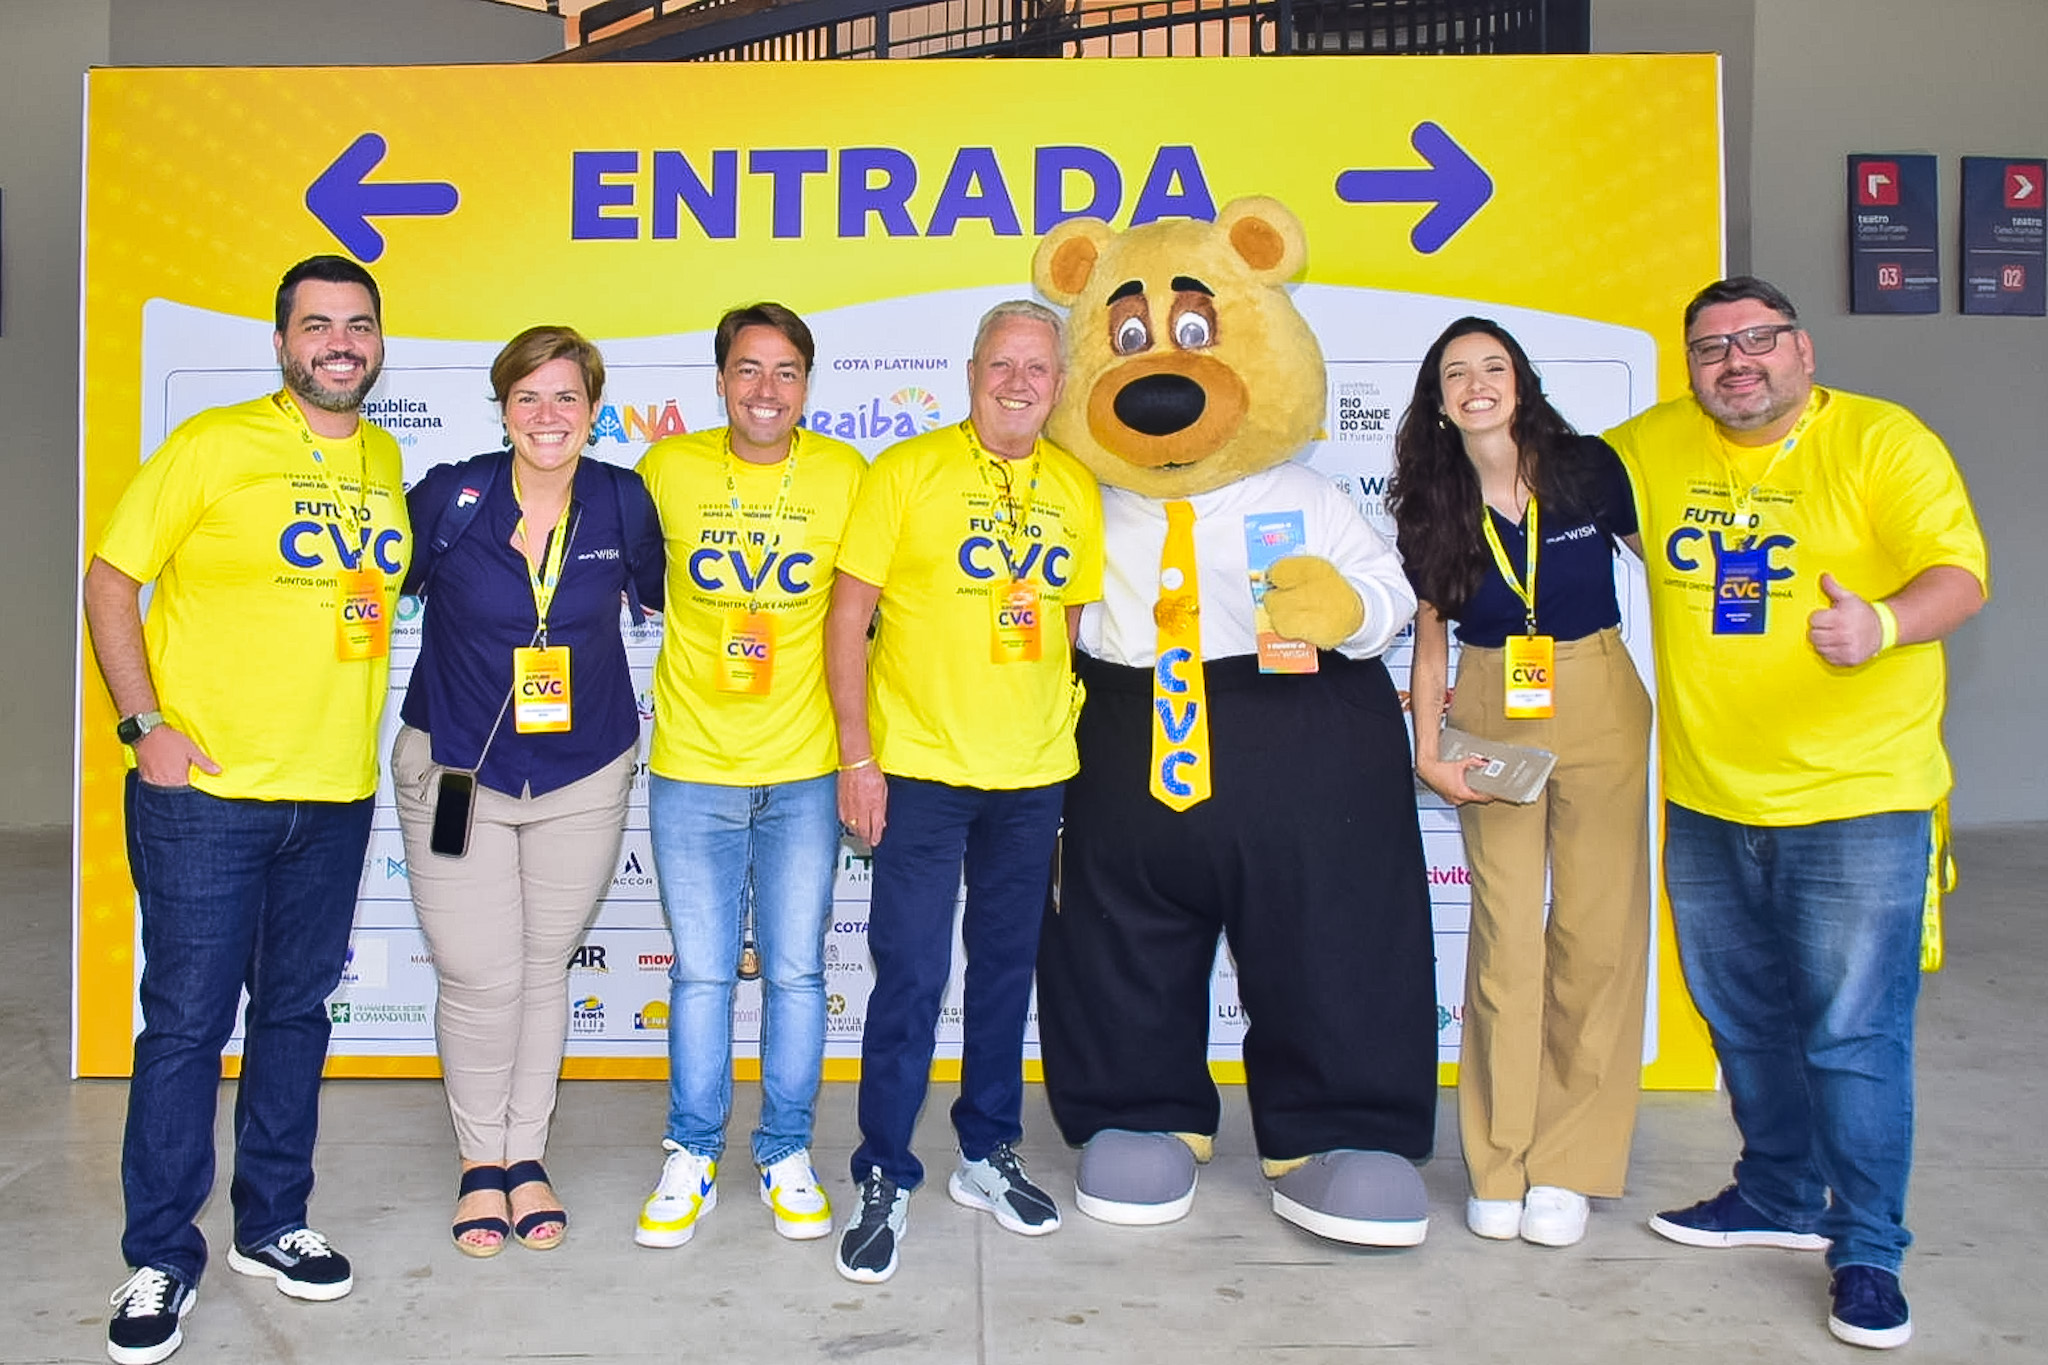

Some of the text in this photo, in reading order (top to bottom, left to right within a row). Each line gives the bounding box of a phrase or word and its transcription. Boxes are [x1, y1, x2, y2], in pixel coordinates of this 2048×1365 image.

[571, 145, 1216, 240] ENTRADA
[1879, 267, 1899, 286] 03
[2003, 269, 2022, 287] 02
[833, 358, 949, 370] COTA PLATINUM
[359, 398, 428, 416] epública
[1340, 398, 1361, 408] RIO
[368, 414, 443, 428] minicana
[1340, 409, 1391, 419] GRANDE
[1340, 420, 1384, 430] DO SUL
[1684, 507, 1760, 529] FUTUO
[1564, 523, 1597, 540] WISH
[280, 521, 403, 575] CVC
[959, 536, 1070, 587] CVC
[689, 548, 814, 594] CVC
[1719, 582, 1761, 599] CVC
[344, 604, 378, 620] CVC
[999, 611, 1034, 626] CVC
[727, 642, 767, 658] CVC
[1512, 668, 1547, 683] CVC
[523, 680, 562, 696] CVC
[1155, 647, 1198, 797] CVC
[612, 877, 653, 886] ACCOR
[638, 955, 672, 965] mov
